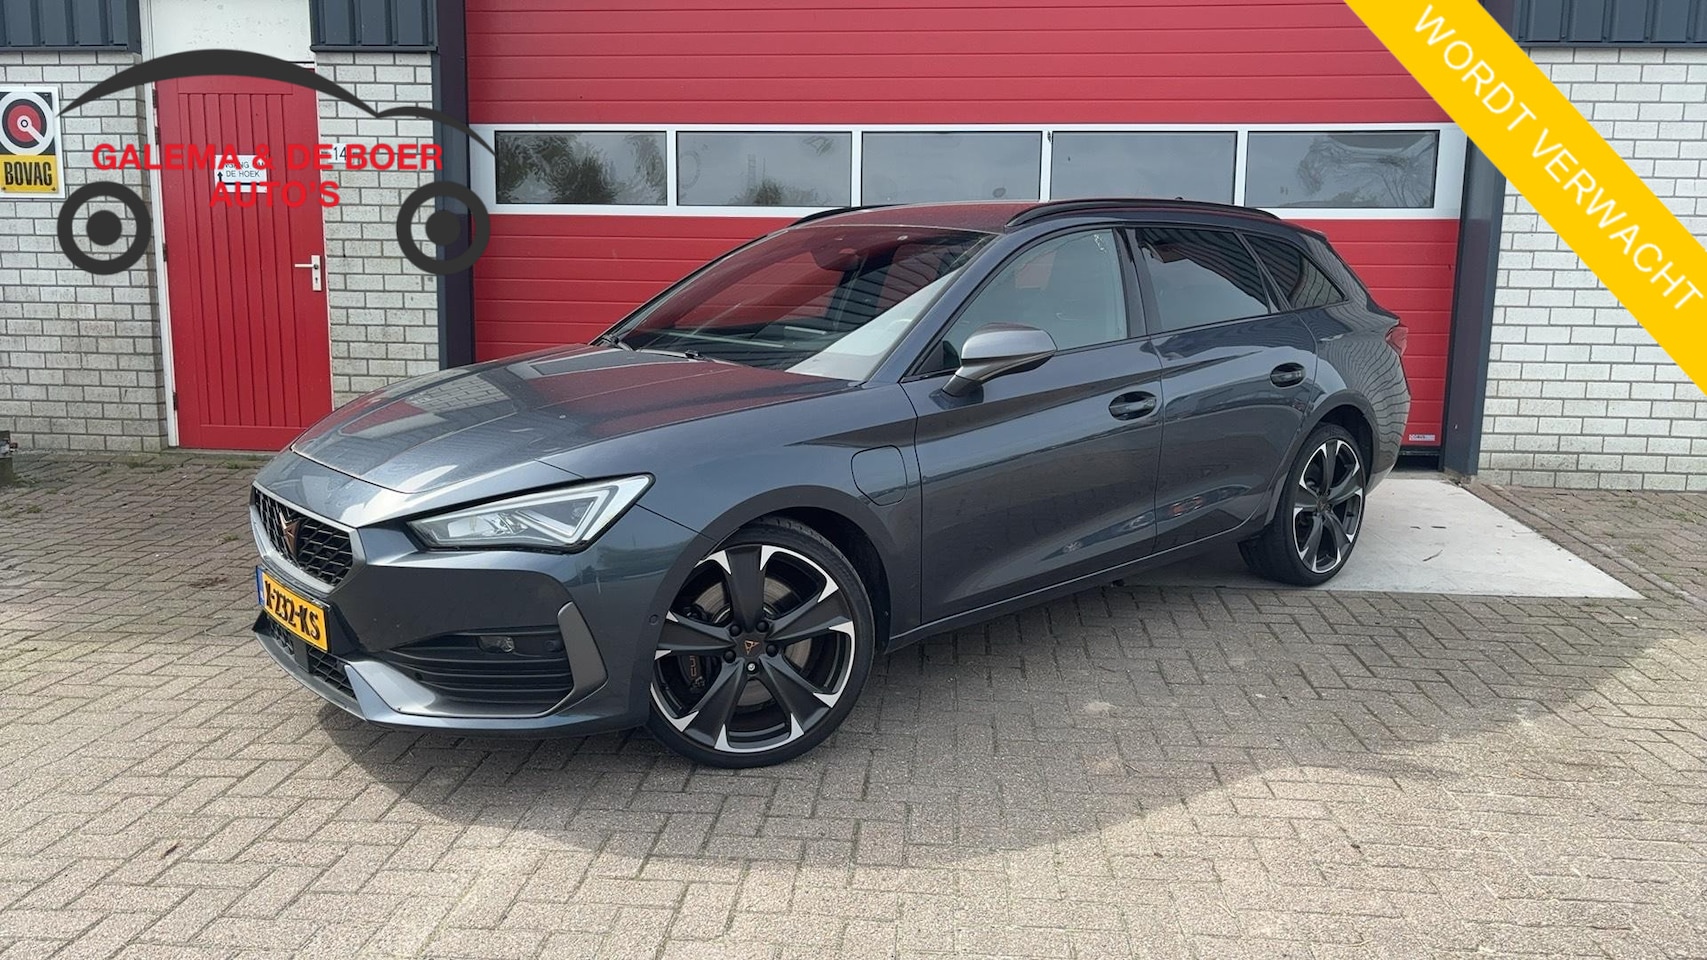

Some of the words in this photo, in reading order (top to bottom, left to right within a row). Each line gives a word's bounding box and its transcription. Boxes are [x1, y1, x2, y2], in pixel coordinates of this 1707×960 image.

[3, 161, 53, 186] BOVAG
[225, 170, 236, 178] DE
[238, 170, 260, 178] HOEK
